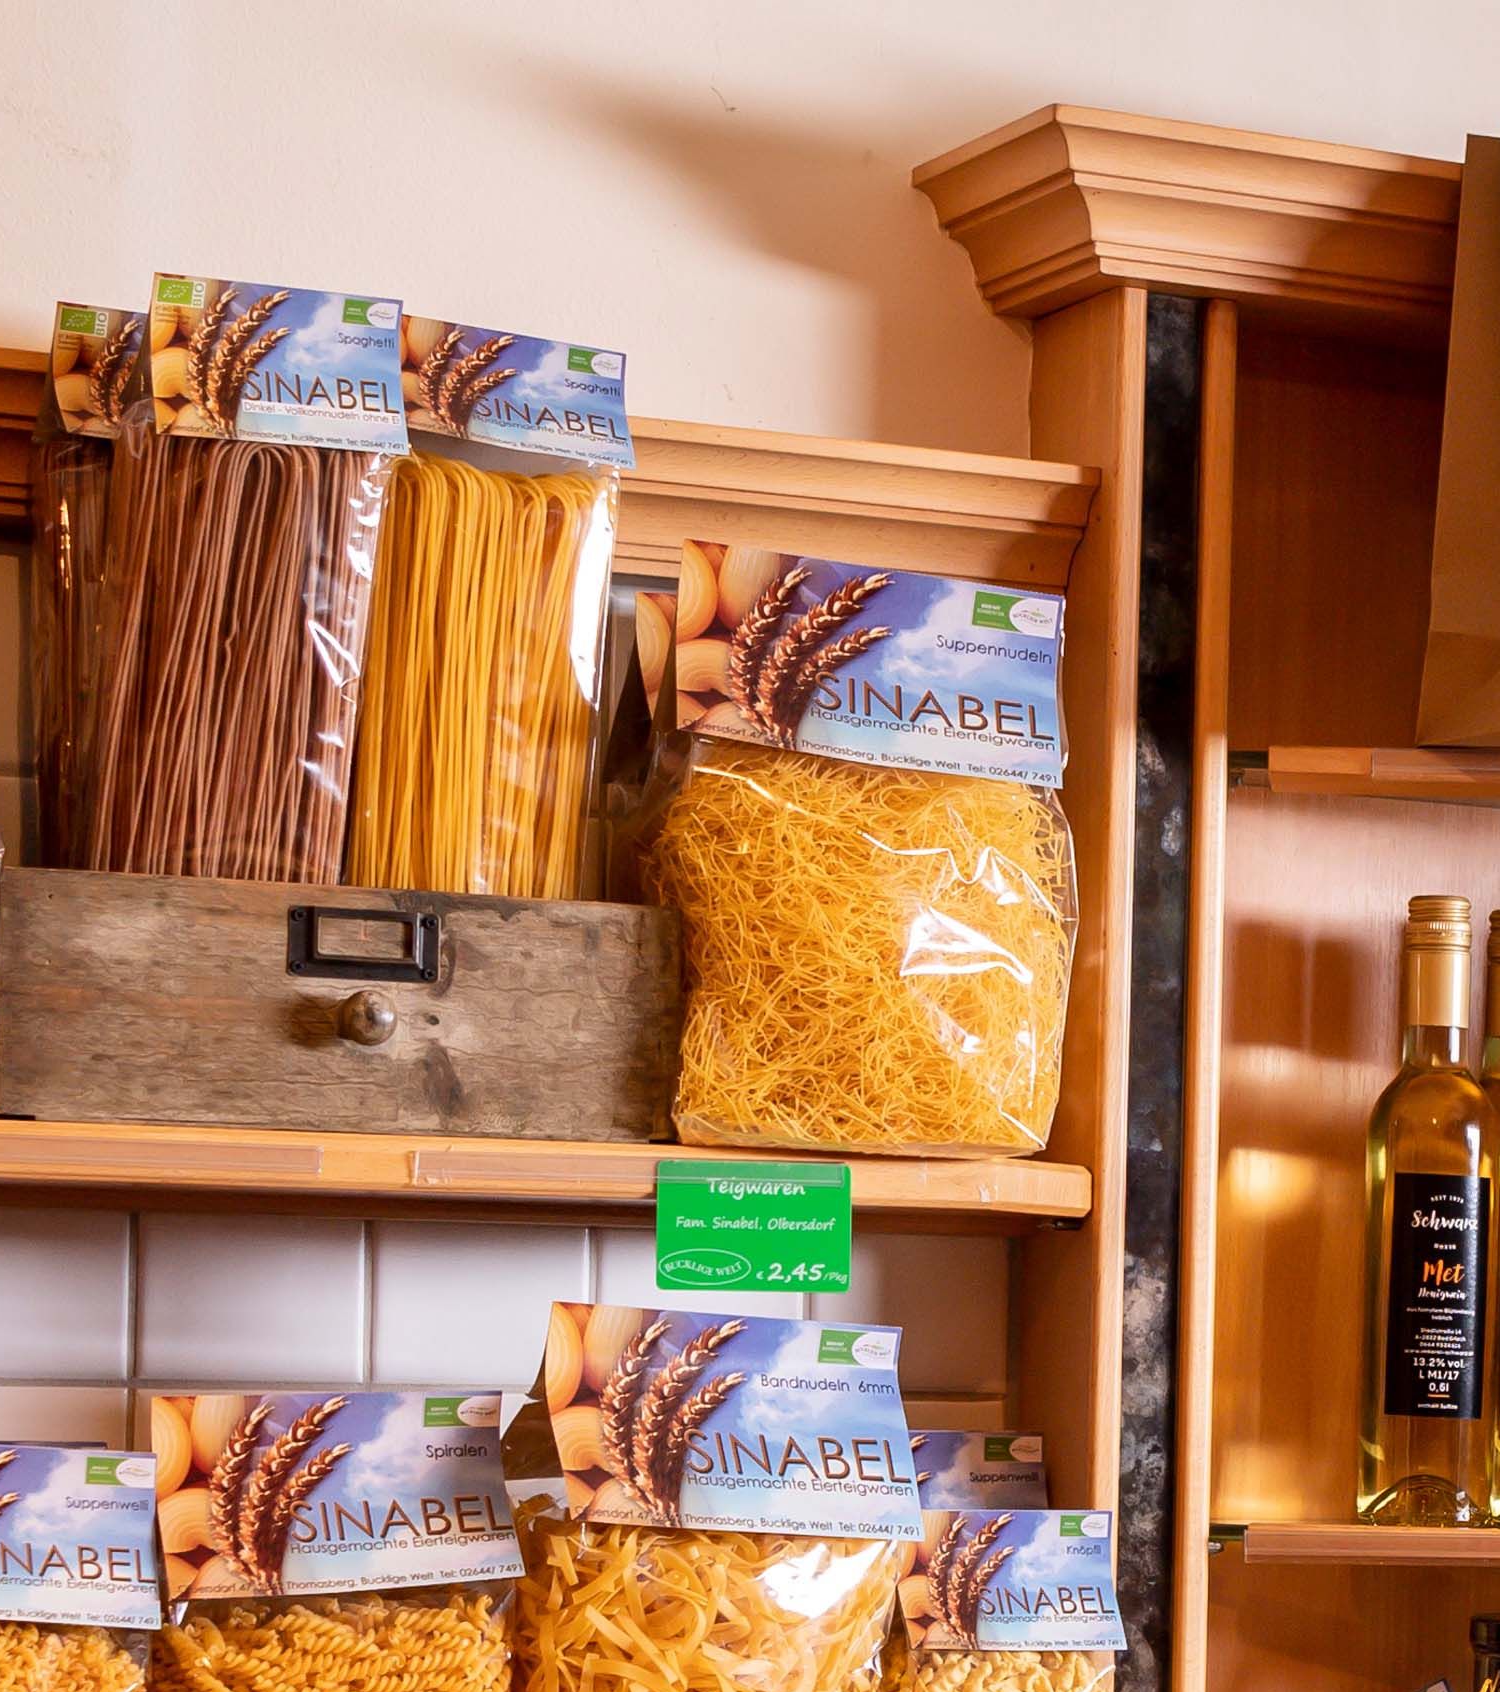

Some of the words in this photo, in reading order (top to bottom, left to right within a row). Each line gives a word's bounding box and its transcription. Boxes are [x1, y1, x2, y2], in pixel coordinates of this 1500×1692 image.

[338, 332, 395, 351] Spaghetti
[243, 369, 400, 413] SINABEL
[937, 635, 1052, 664] Suppennudeln
[815, 671, 1054, 740] SINABEL
[881, 753, 931, 769] Bucklige
[934, 759, 960, 771] Welt
[967, 763, 985, 774] Tel:
[1032, 771, 1058, 784] 7491
[706, 1177, 805, 1200] Teigwaren
[1411, 1210, 1478, 1230] Schwarz
[1423, 1259, 1464, 1284] Met
[761, 1374, 850, 1392] Bandnudeln
[858, 1380, 895, 1394] 6mm
[426, 1444, 488, 1461] Spiralen
[684, 1428, 911, 1483] SINABEL
[291, 1496, 512, 1542] SINABEL
